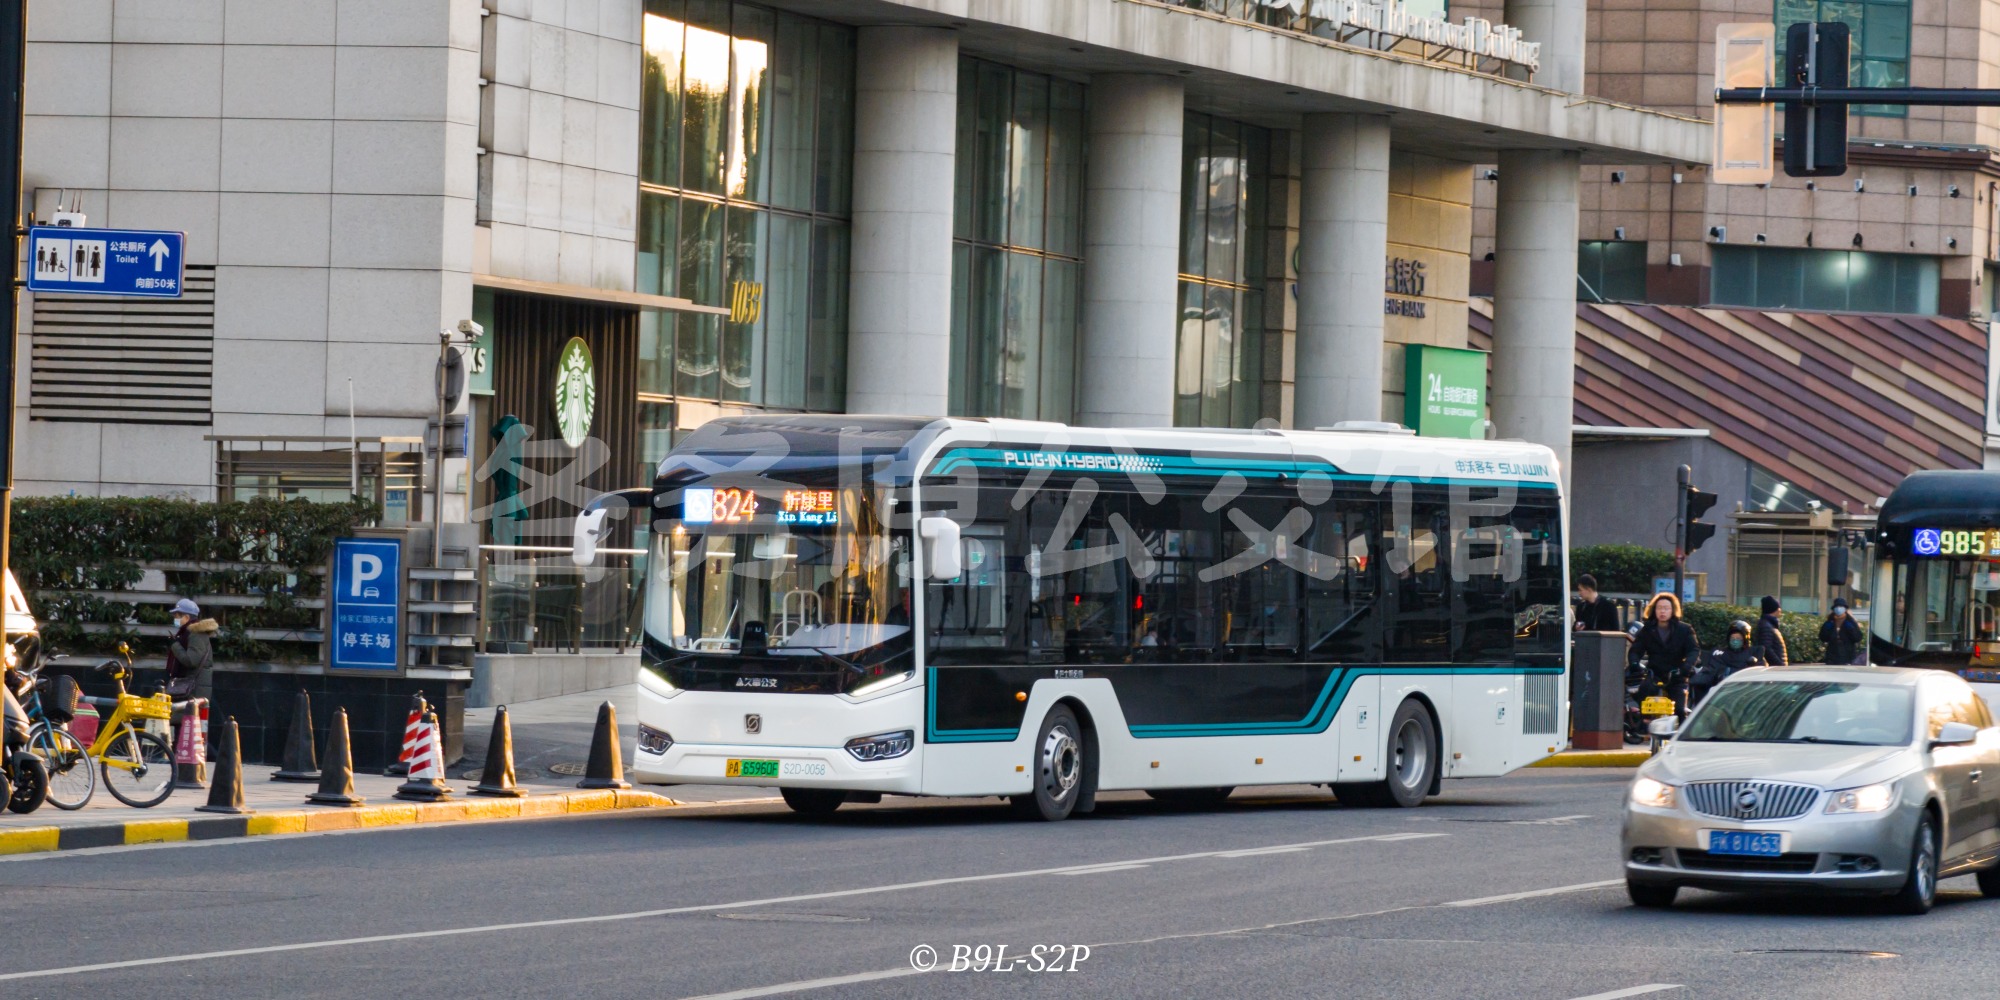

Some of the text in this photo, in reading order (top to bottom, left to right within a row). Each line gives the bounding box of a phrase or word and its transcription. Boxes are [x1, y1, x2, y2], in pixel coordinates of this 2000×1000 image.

[1475, 17, 1541, 73] Building
[110, 241, 146, 253] 公共厕所
[116, 255, 138, 264] Toilet
[135, 277, 176, 290] 向前50米
[730, 280, 763, 324] 1033
[1403, 301, 1426, 318] BANK
[1428, 373, 1442, 401] 24
[1004, 452, 1118, 470] PLUG-IN HYBRID
[1455, 460, 1549, 477] 申沃客车 SUNWIN
[713, 489, 755, 522] 824
[777, 511, 838, 523] Xin Kang Li
[1940, 531, 1986, 554] 985
[351, 553, 383, 596] P
[343, 632, 391, 648] 停车场
[784, 763, 826, 776] S2D-0058
